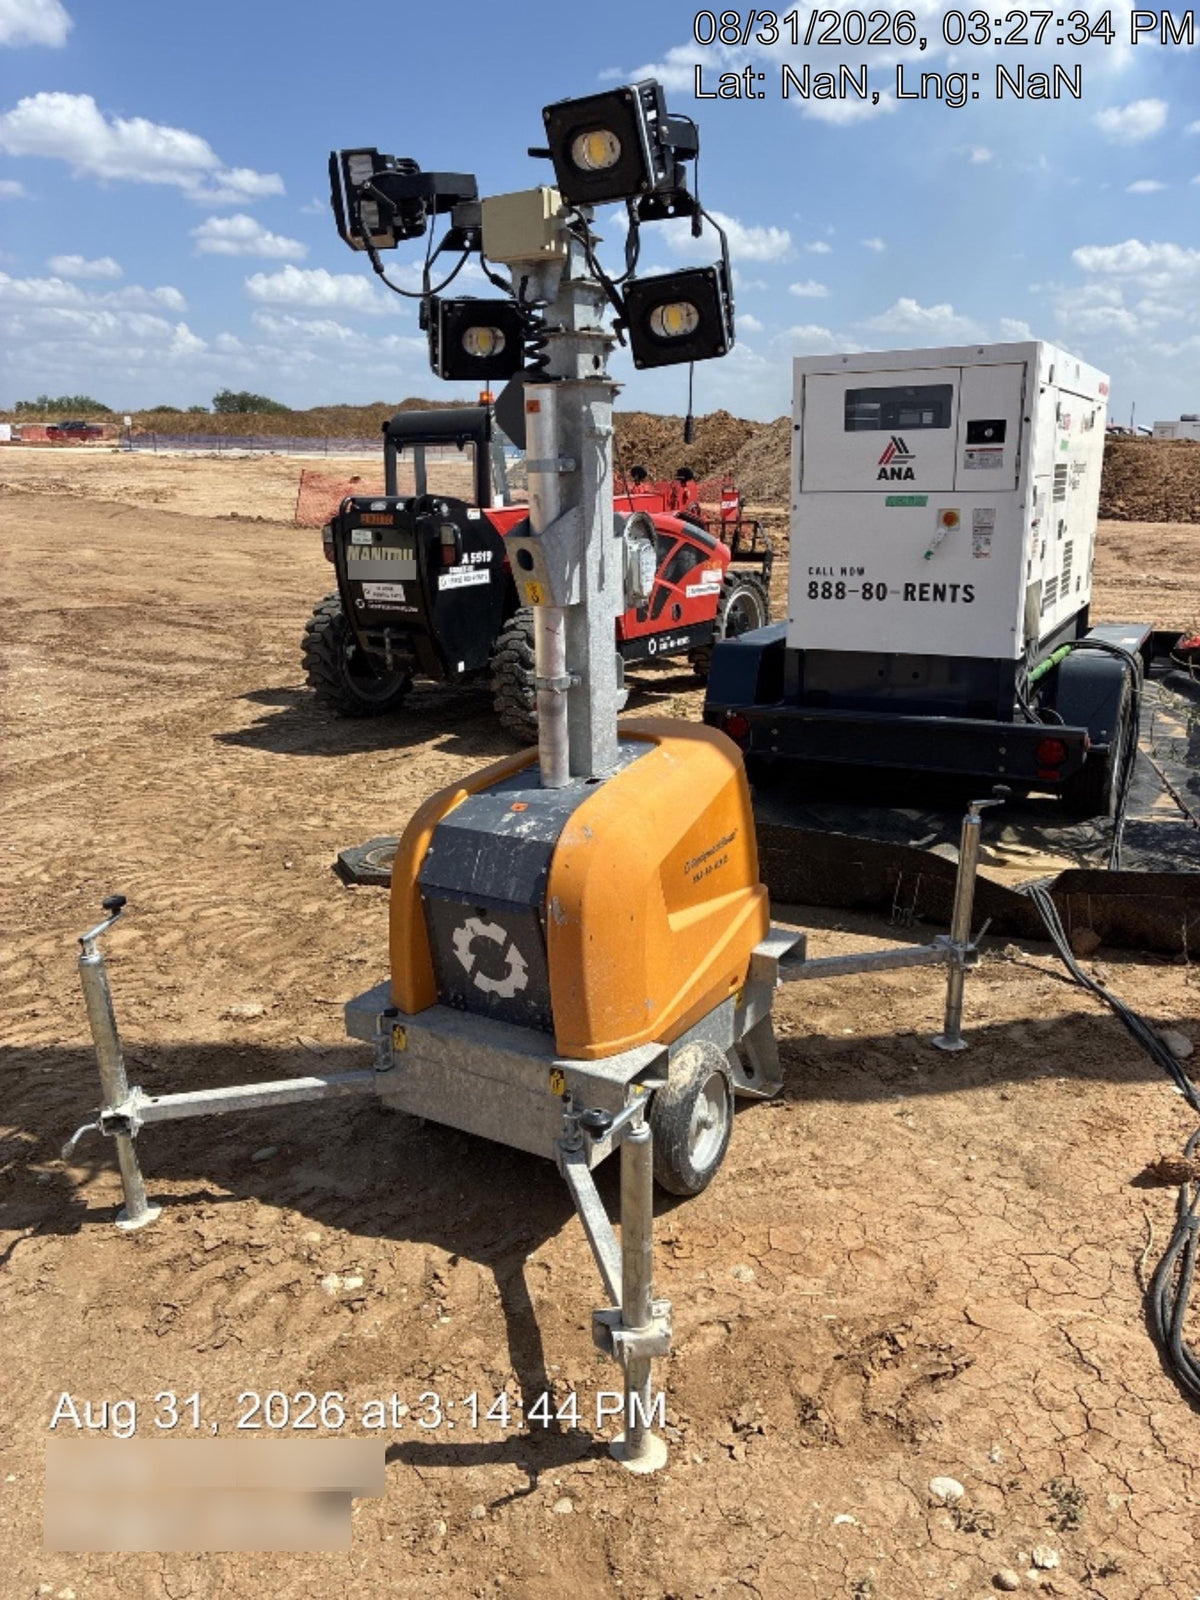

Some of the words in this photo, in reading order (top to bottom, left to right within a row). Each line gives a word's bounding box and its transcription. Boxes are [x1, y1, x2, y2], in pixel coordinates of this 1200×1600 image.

[876, 466, 916, 481] ANA
[807, 566, 835, 577] CALL
[840, 566, 866, 577] NOW
